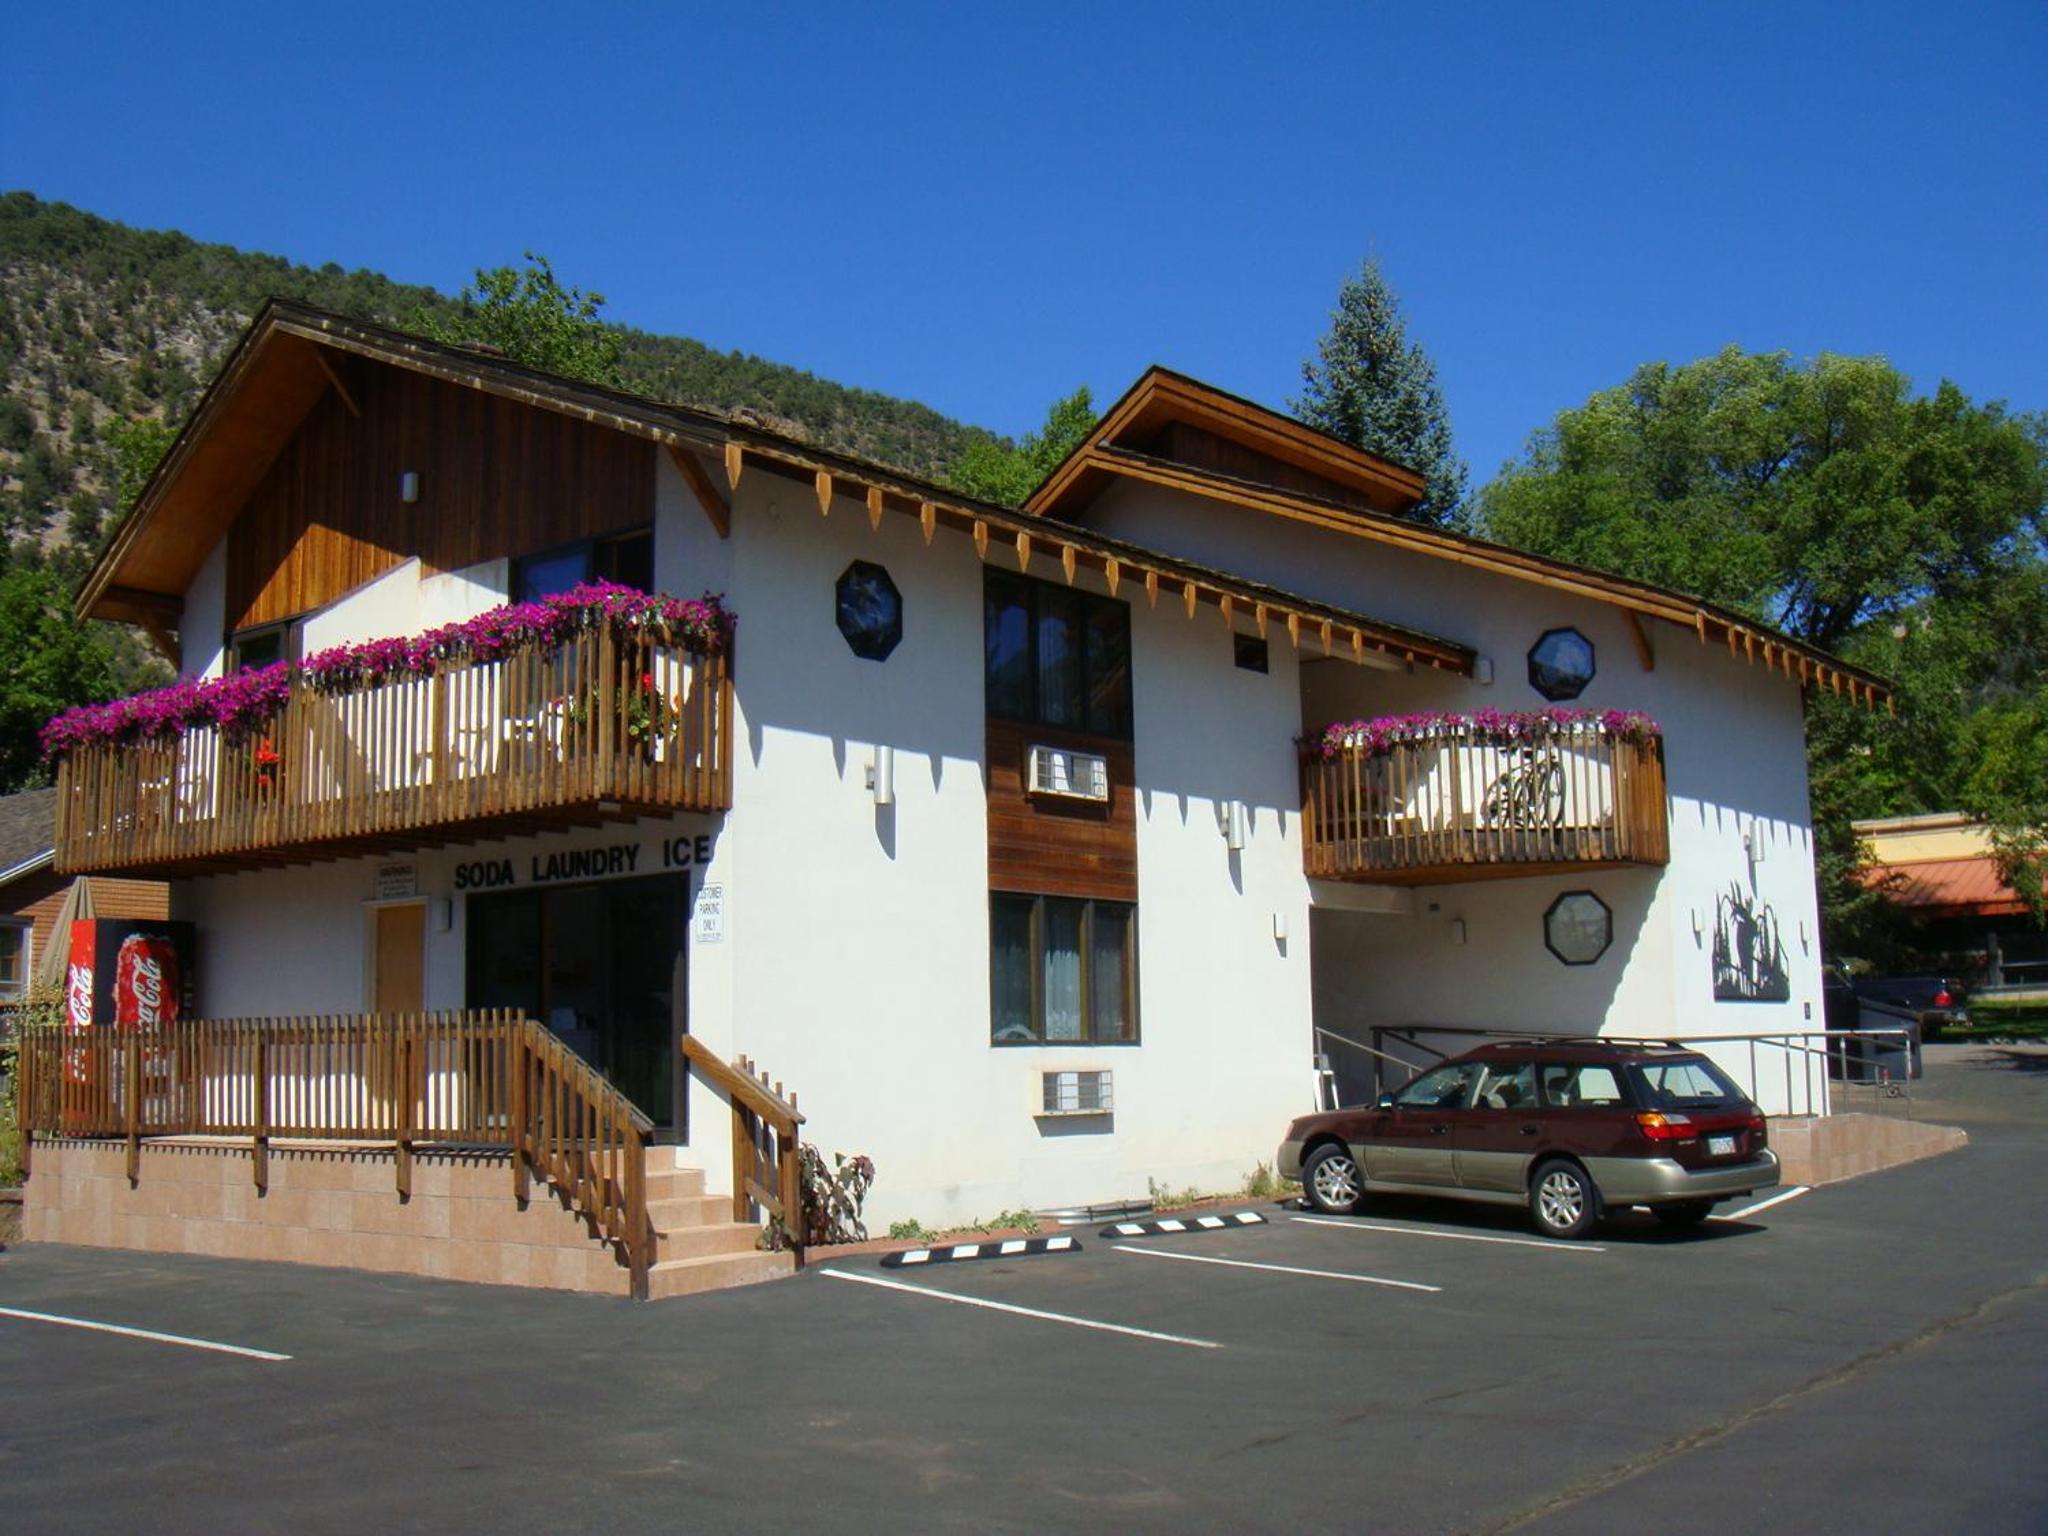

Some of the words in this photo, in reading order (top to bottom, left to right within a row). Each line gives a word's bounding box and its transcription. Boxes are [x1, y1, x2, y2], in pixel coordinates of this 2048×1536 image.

[454, 860, 515, 889] SODA
[532, 844, 640, 882] LAUNDRY
[663, 835, 714, 867] ICE
